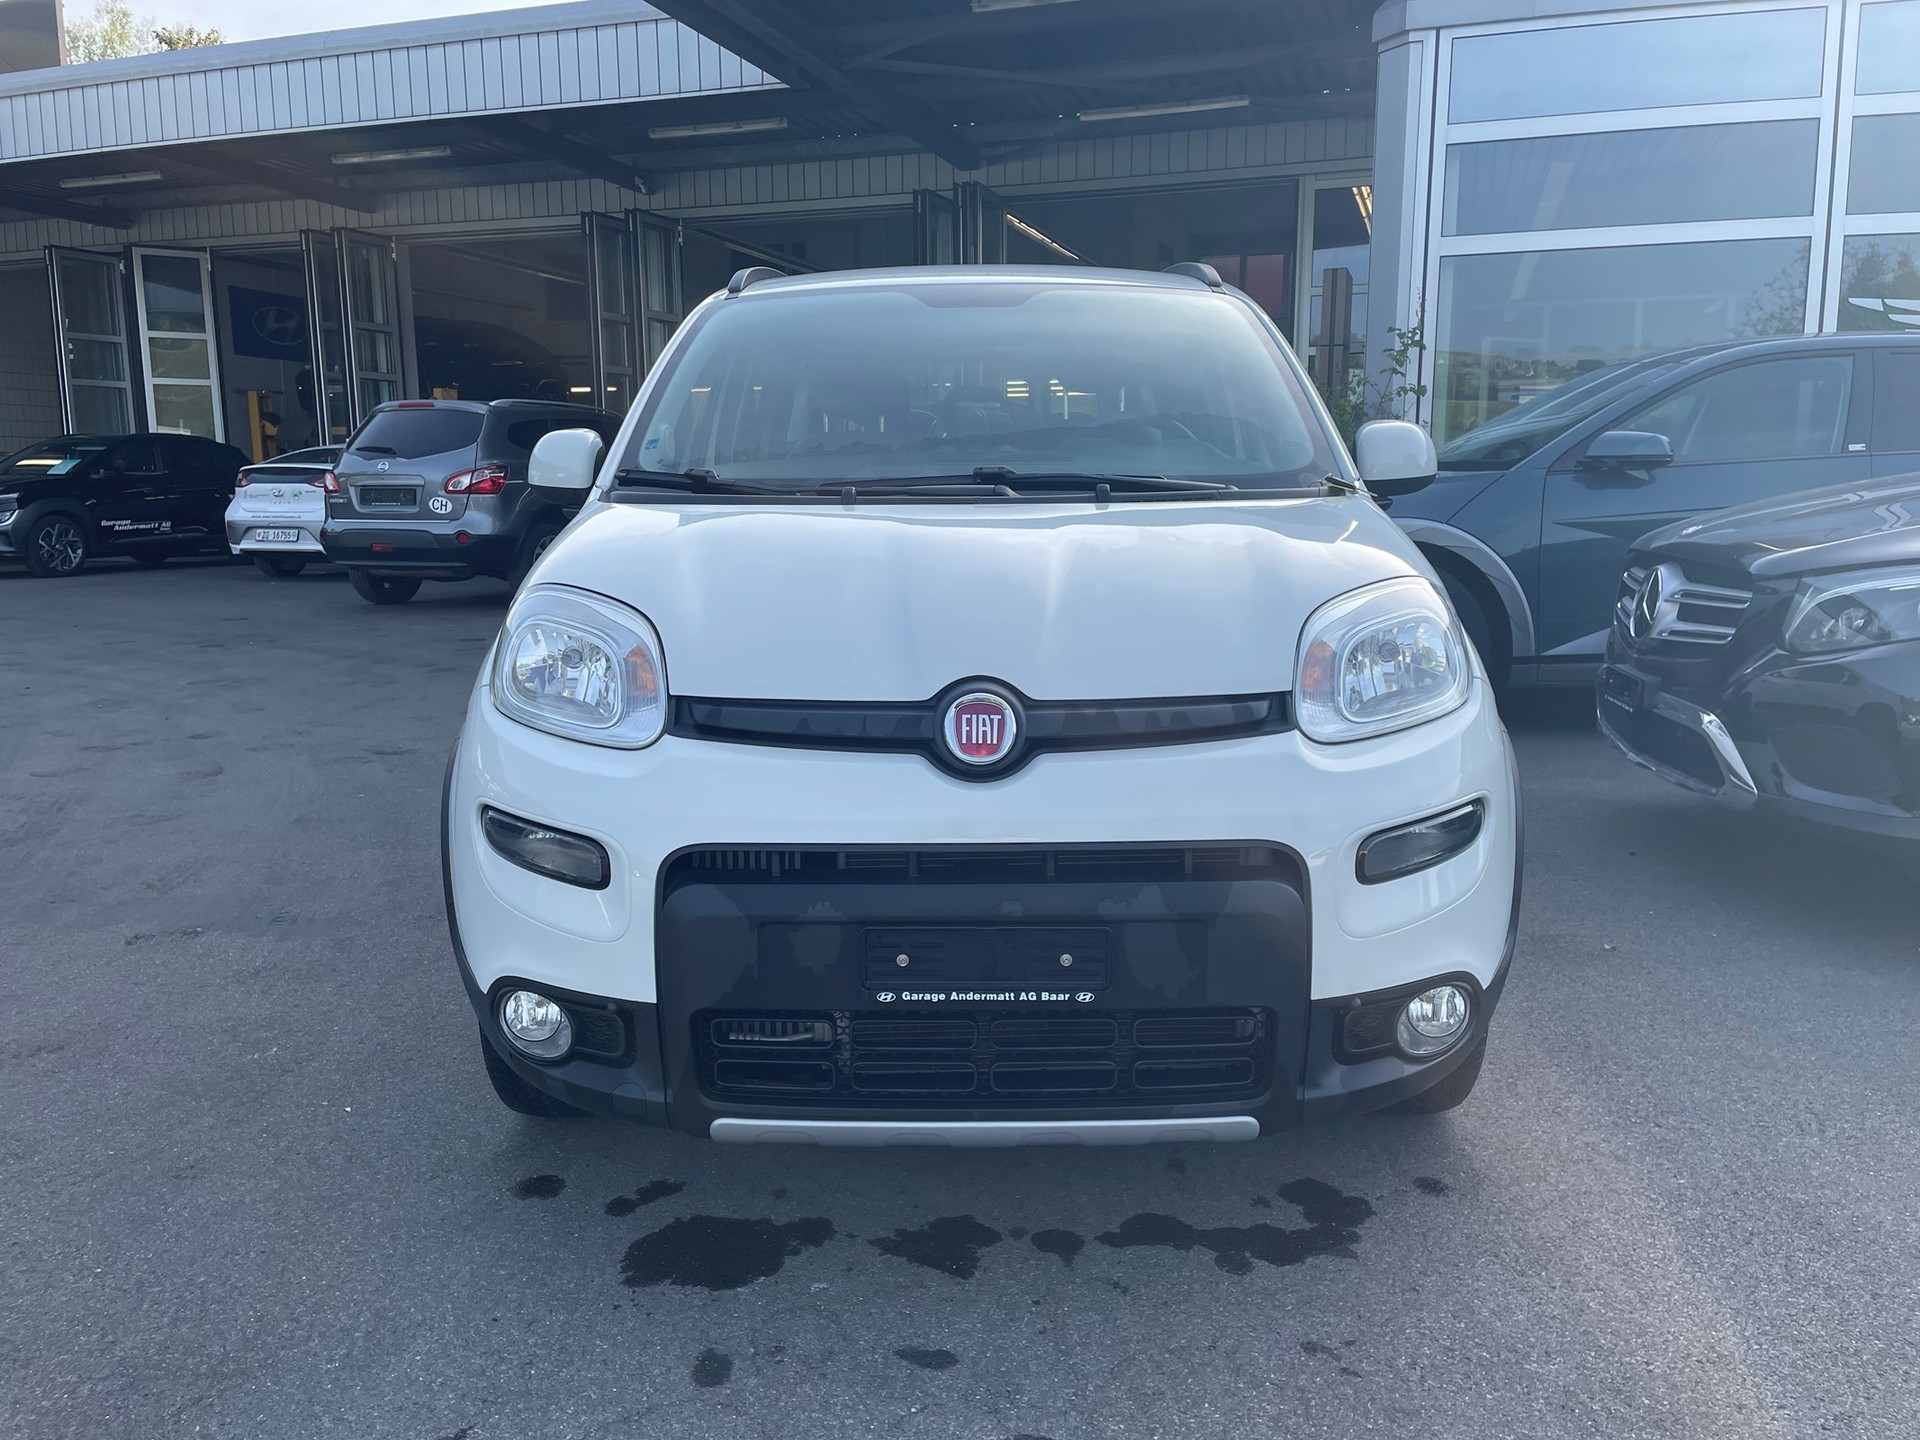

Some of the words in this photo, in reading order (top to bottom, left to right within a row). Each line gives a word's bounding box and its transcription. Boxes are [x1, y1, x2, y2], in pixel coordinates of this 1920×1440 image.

[432, 499, 448, 511] CH
[113, 523, 159, 531] Andermatt
[961, 714, 1002, 744] FIAT
[902, 991, 946, 1002] Garage
[950, 991, 1015, 1001] Andermatt
[1019, 991, 1037, 1001] AG
[1041, 992, 1070, 1001] Baar
